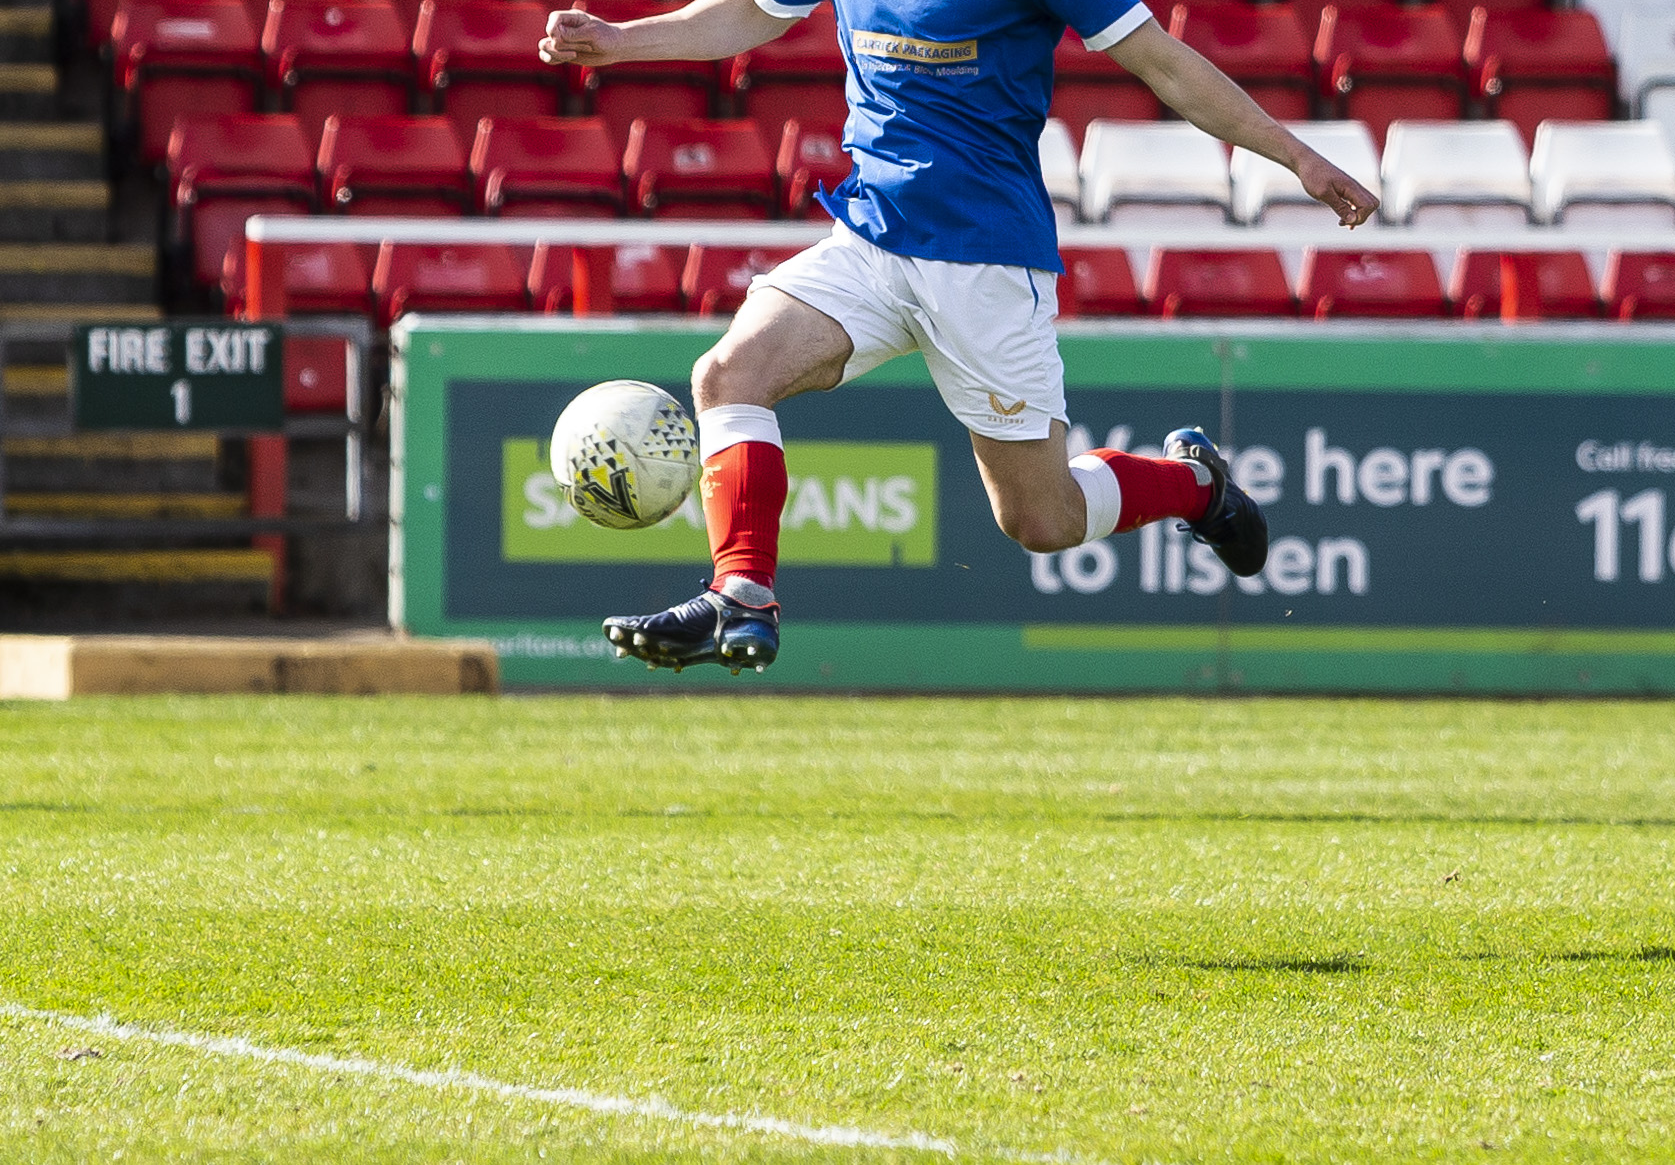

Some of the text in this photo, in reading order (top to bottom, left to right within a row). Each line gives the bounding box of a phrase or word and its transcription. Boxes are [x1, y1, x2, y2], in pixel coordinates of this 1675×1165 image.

[902, 43, 971, 59] PACKAGING
[936, 65, 979, 77] Moulding
[88, 328, 272, 374] FIRE EXIT
[170, 379, 192, 425] 1
[1303, 427, 1495, 507] here
[1575, 439, 1633, 473] Call
[1139, 519, 1370, 595] lisen
